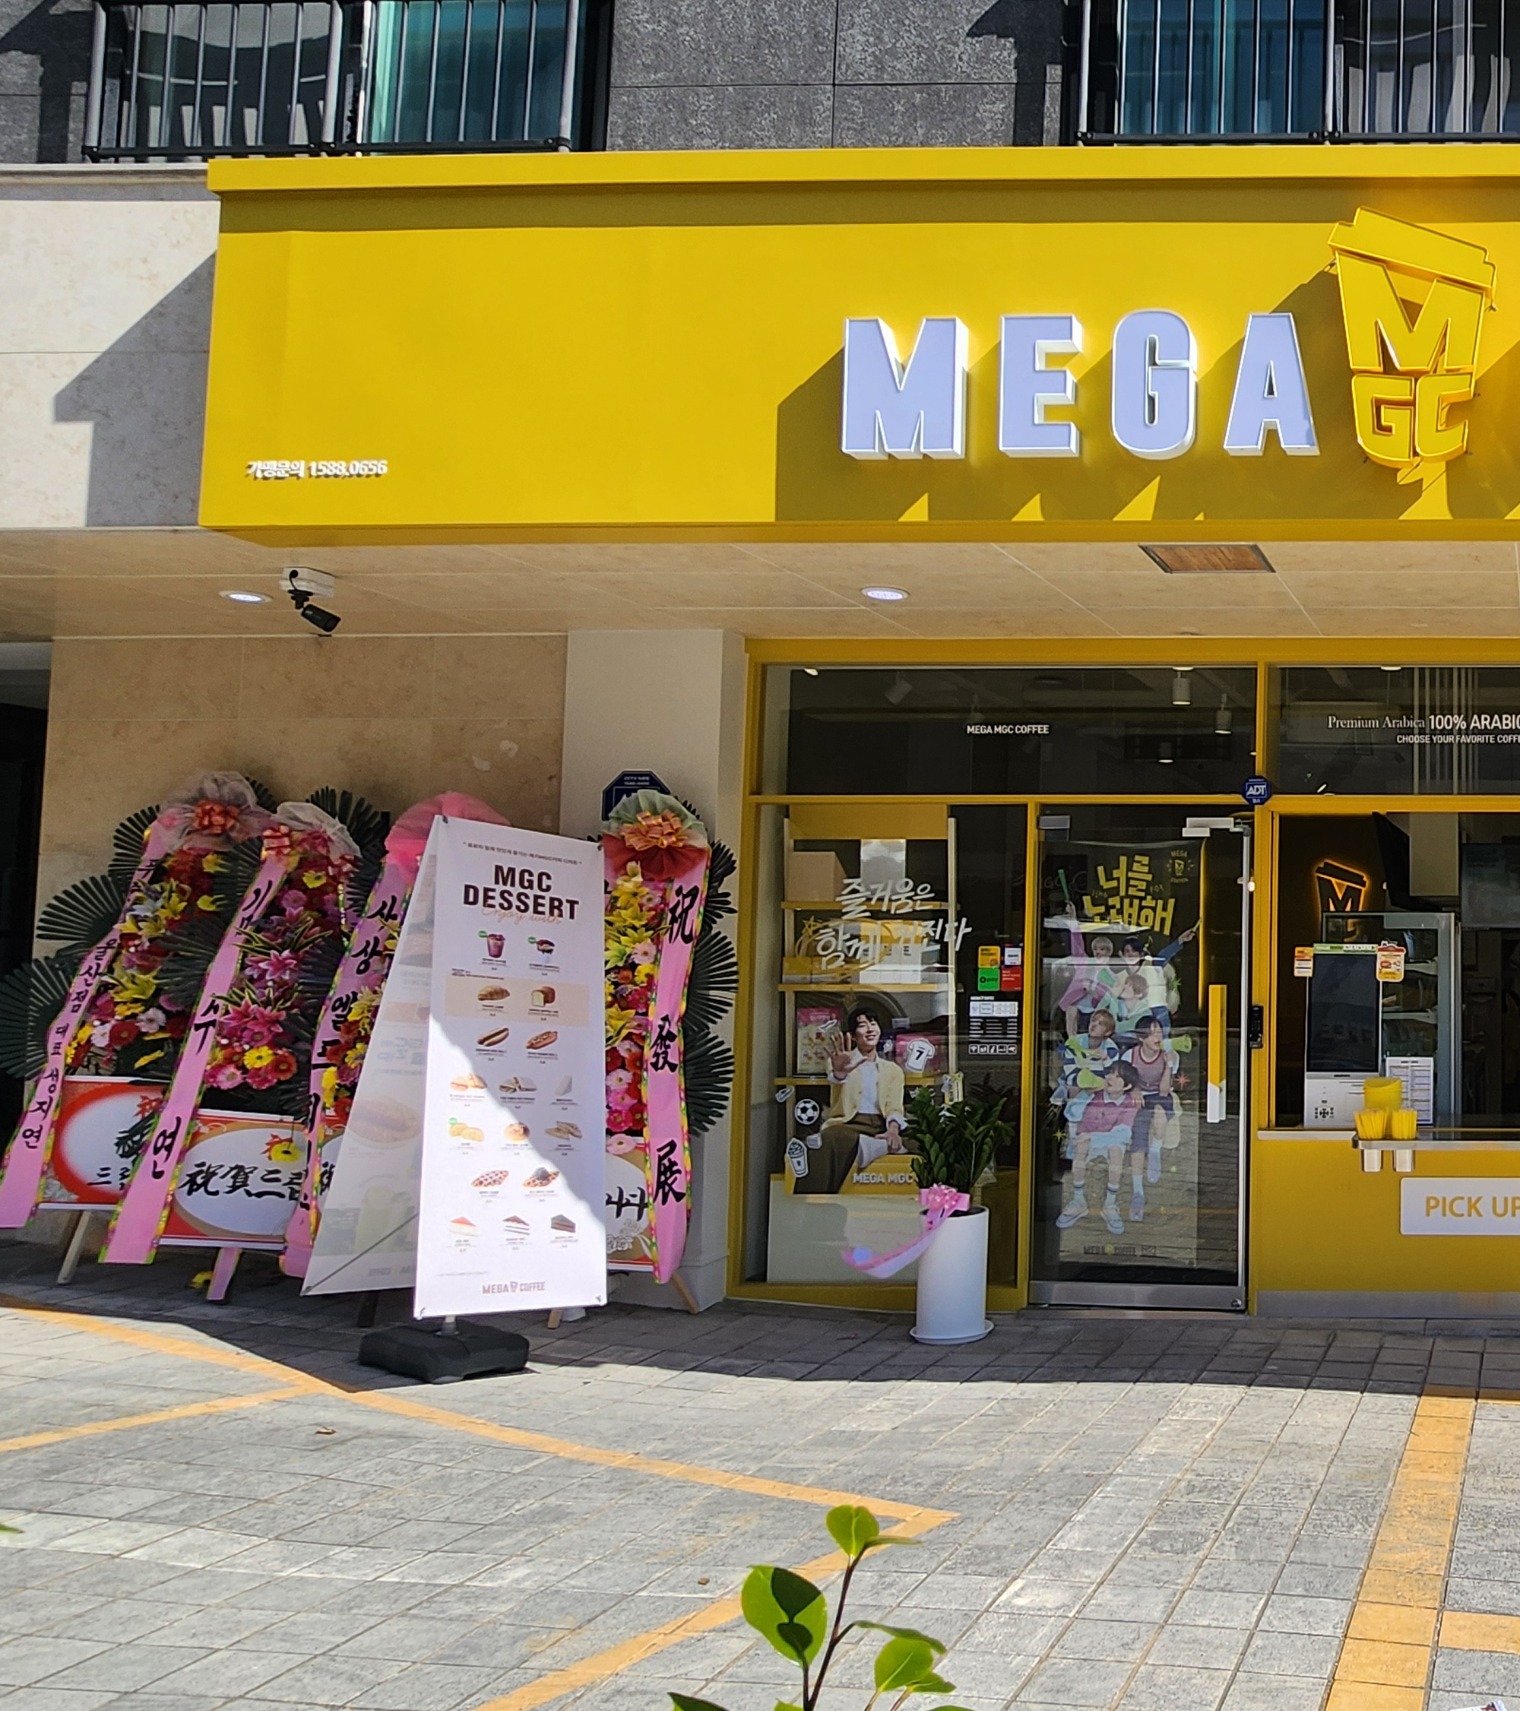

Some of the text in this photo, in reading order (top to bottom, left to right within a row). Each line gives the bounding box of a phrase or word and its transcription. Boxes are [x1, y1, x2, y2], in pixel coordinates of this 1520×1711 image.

[841, 308, 1320, 460] MEGA
[246, 459, 389, 479] 가맹문의 1588.0656
[966, 724, 1050, 735] MEGA MGC COFFEE
[1328, 714, 1379, 729] Premium
[1382, 714, 1426, 729] Arabica
[1429, 714, 1467, 730] 100%
[1396, 734, 1431, 744] CHOOSE
[1431, 734, 1454, 744] YOUR
[1455, 734, 1496, 744] FAVORITE
[1246, 784, 1267, 796] ADT
[494, 863, 552, 893] MGC
[1096, 854, 1153, 897] 너를
[462, 883, 579, 920] DESSERT
[836, 877, 936, 920] 즐거움은
[1082, 894, 1176, 936] 노래해
[815, 920, 882, 970] 함께
[914, 1049, 924, 1061] 7
[852, 1172, 914, 1184] MEGA MGC
[1424, 1195, 1483, 1218] PICK
[482, 1280, 546, 1295] MEGA COFFEE
